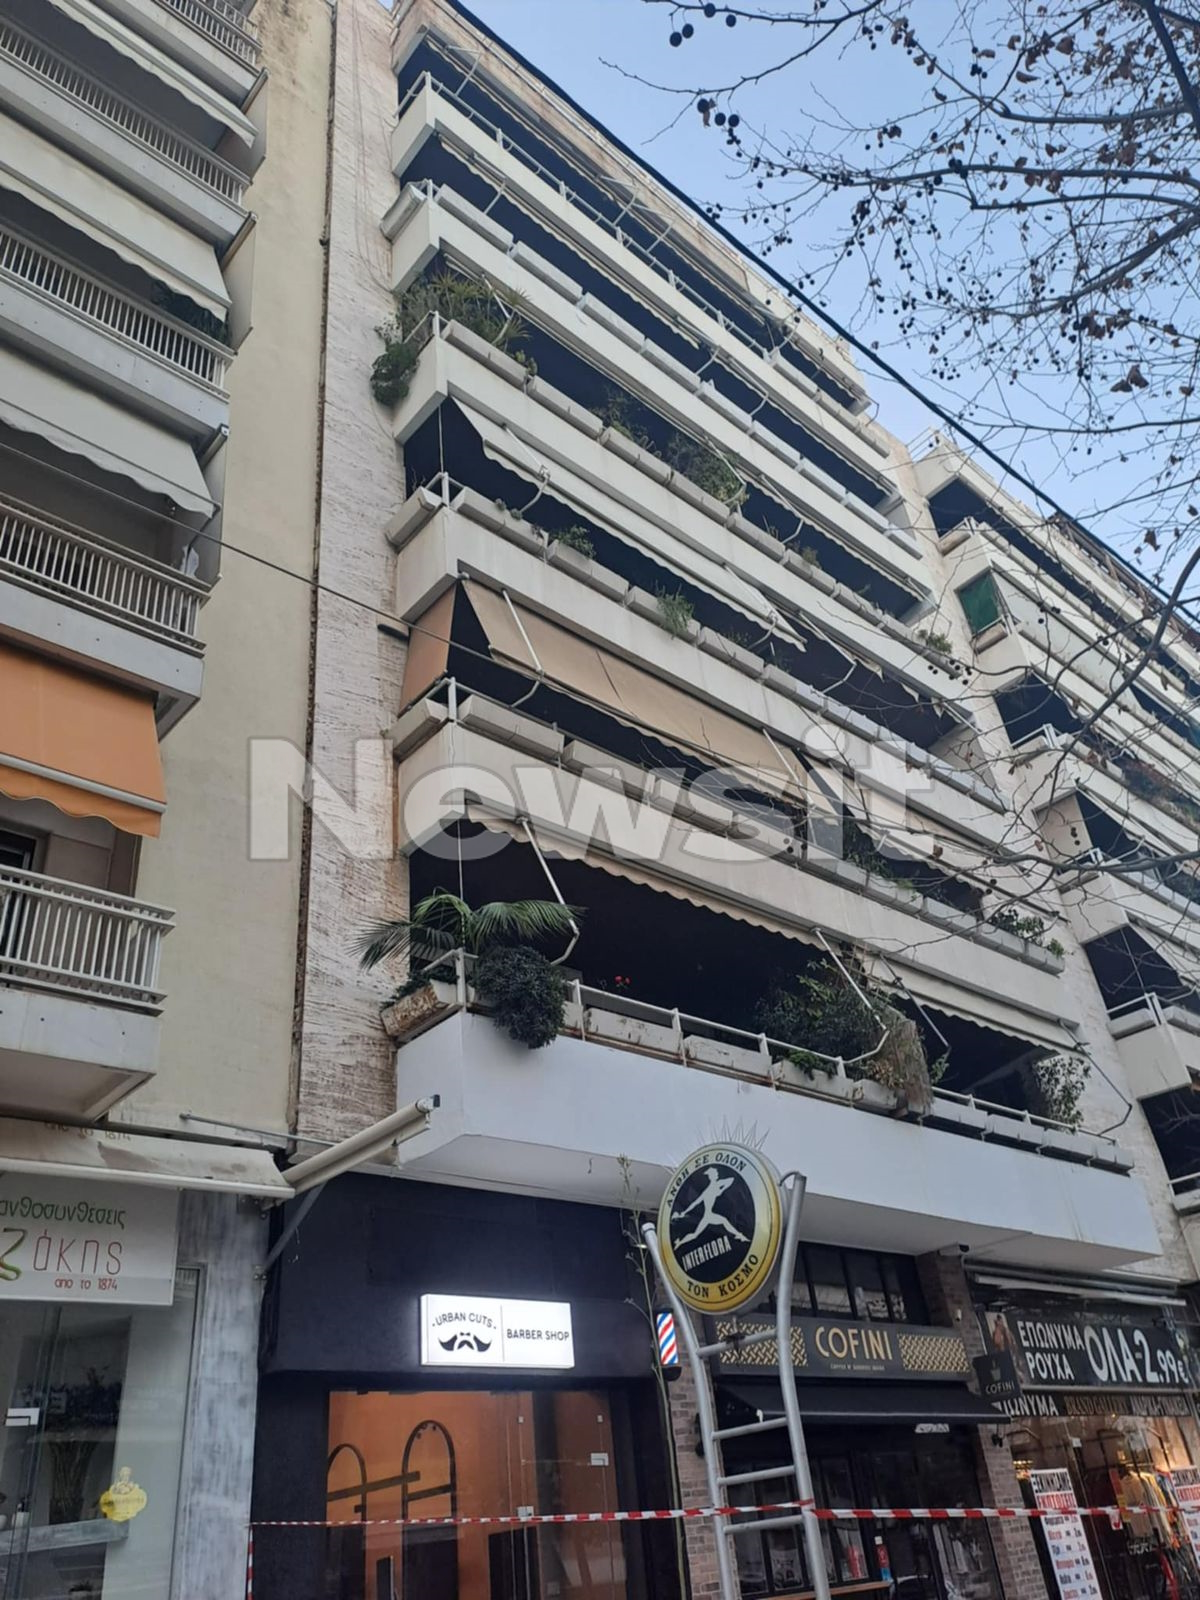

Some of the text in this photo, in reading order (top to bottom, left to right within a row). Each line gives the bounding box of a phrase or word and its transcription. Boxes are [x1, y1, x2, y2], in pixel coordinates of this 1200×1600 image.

[695, 1154, 710, 1168] ΣΕ
[715, 1152, 747, 1172] ΟΛΟΝ
[682, 1235, 732, 1272] INTERFLORA
[98, 1278, 117, 1291] 1874
[687, 1254, 759, 1298] ΤΟΝ ΚΟΣΜΟ
[435, 1312, 494, 1328] URBAN CUTS
[506, 1328, 570, 1341] BARBER SHOP
[815, 1326, 893, 1360] COFINI
[1017, 1320, 1085, 1350] ΕΠΩΝΥΜΑ
[1025, 1352, 1075, 1381] ΡΟΥΧΑ
[985, 1381, 1015, 1395] COFINI
